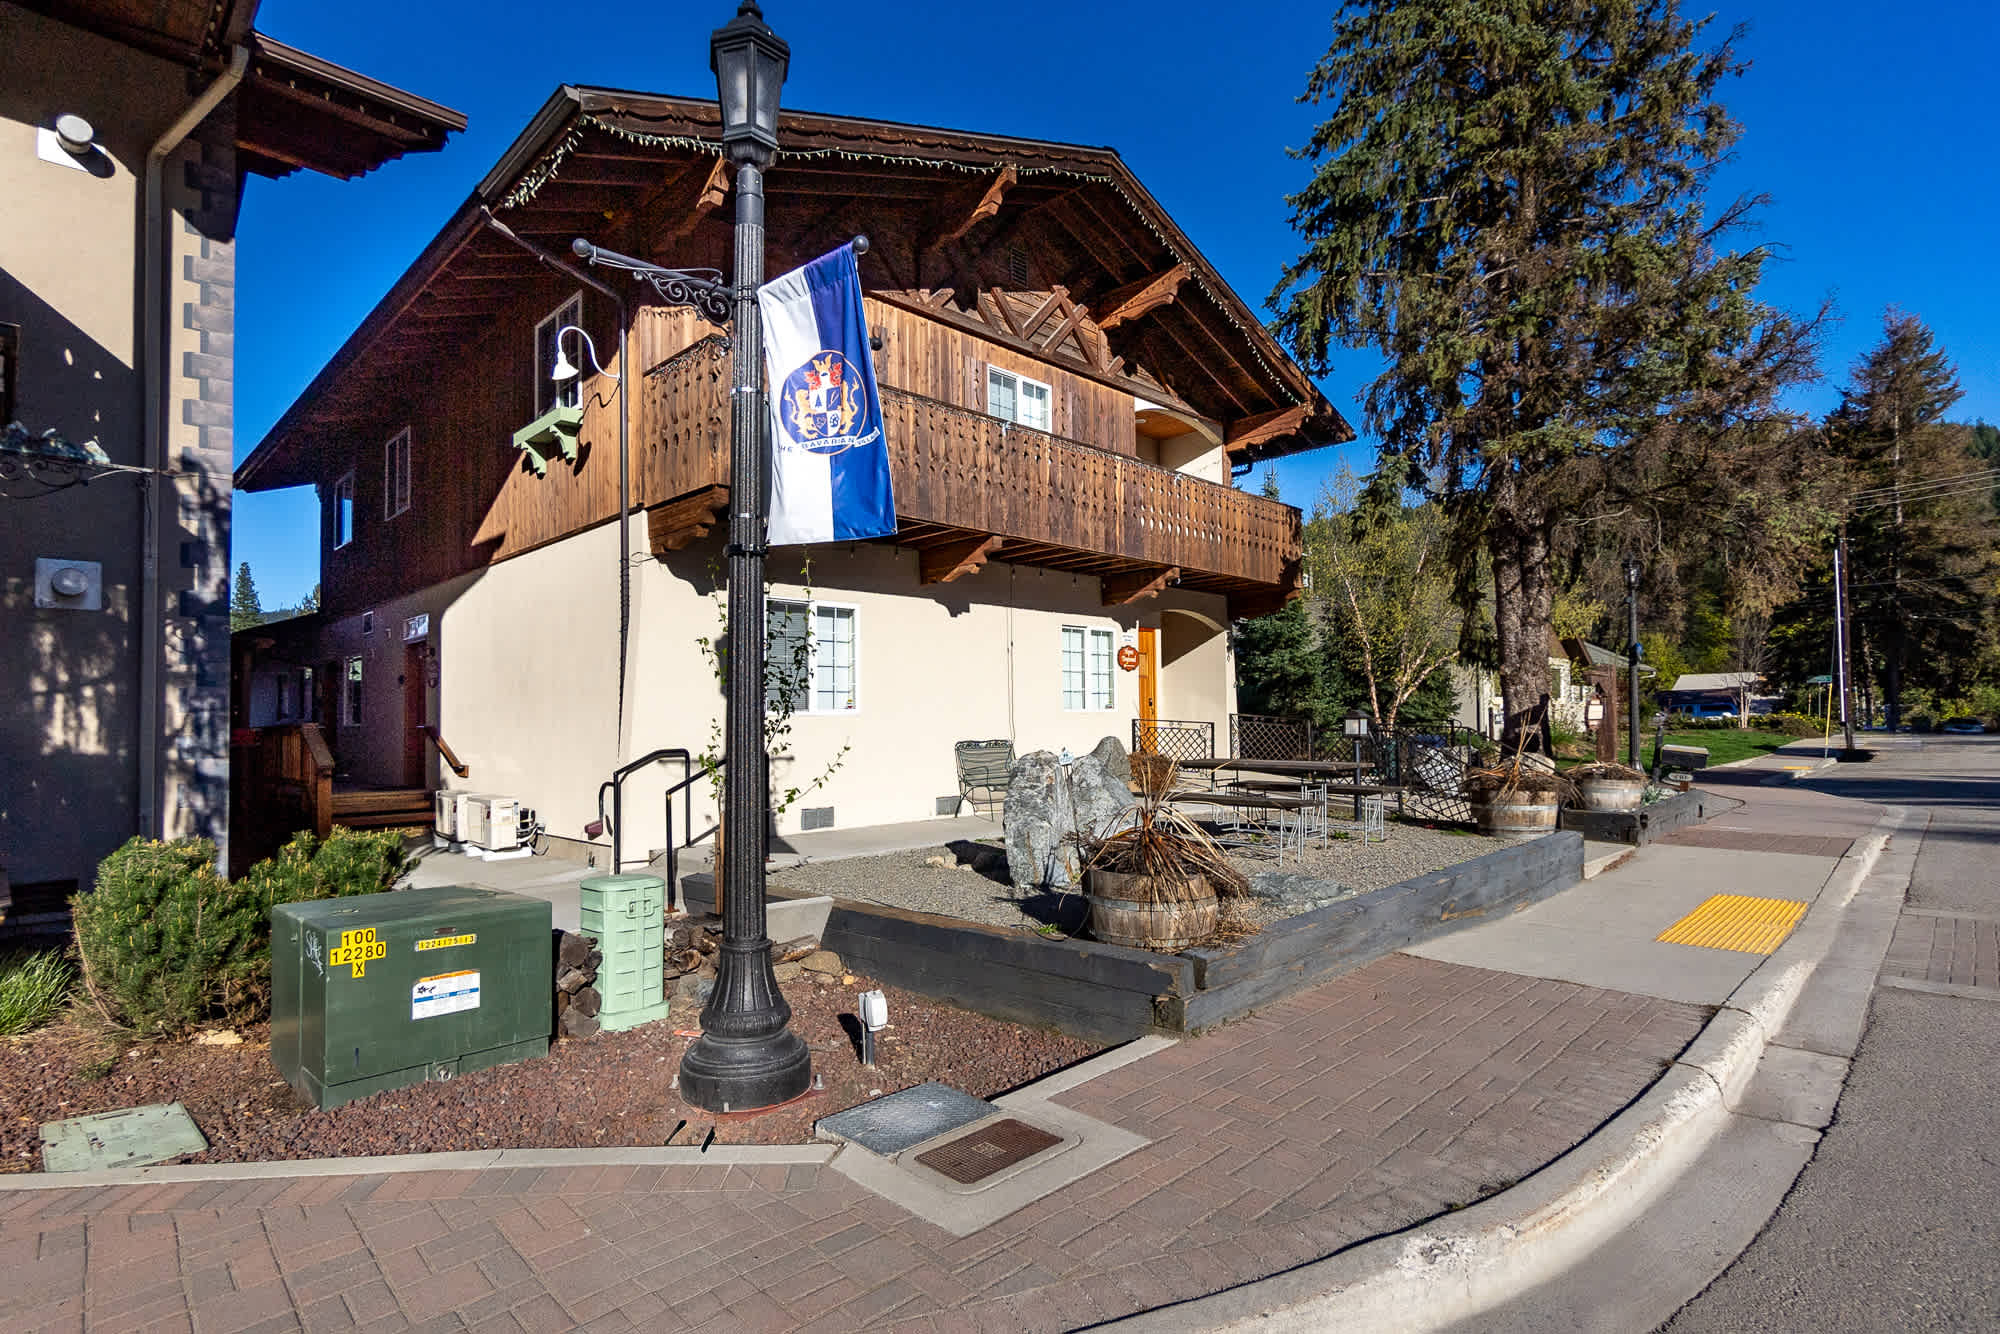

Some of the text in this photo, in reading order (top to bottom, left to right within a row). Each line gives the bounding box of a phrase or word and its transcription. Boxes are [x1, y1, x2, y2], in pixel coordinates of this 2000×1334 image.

[802, 437, 854, 449] BAVARIAN
[344, 930, 374, 946] 100
[332, 944, 384, 963] 12280
[355, 961, 363, 976] X
